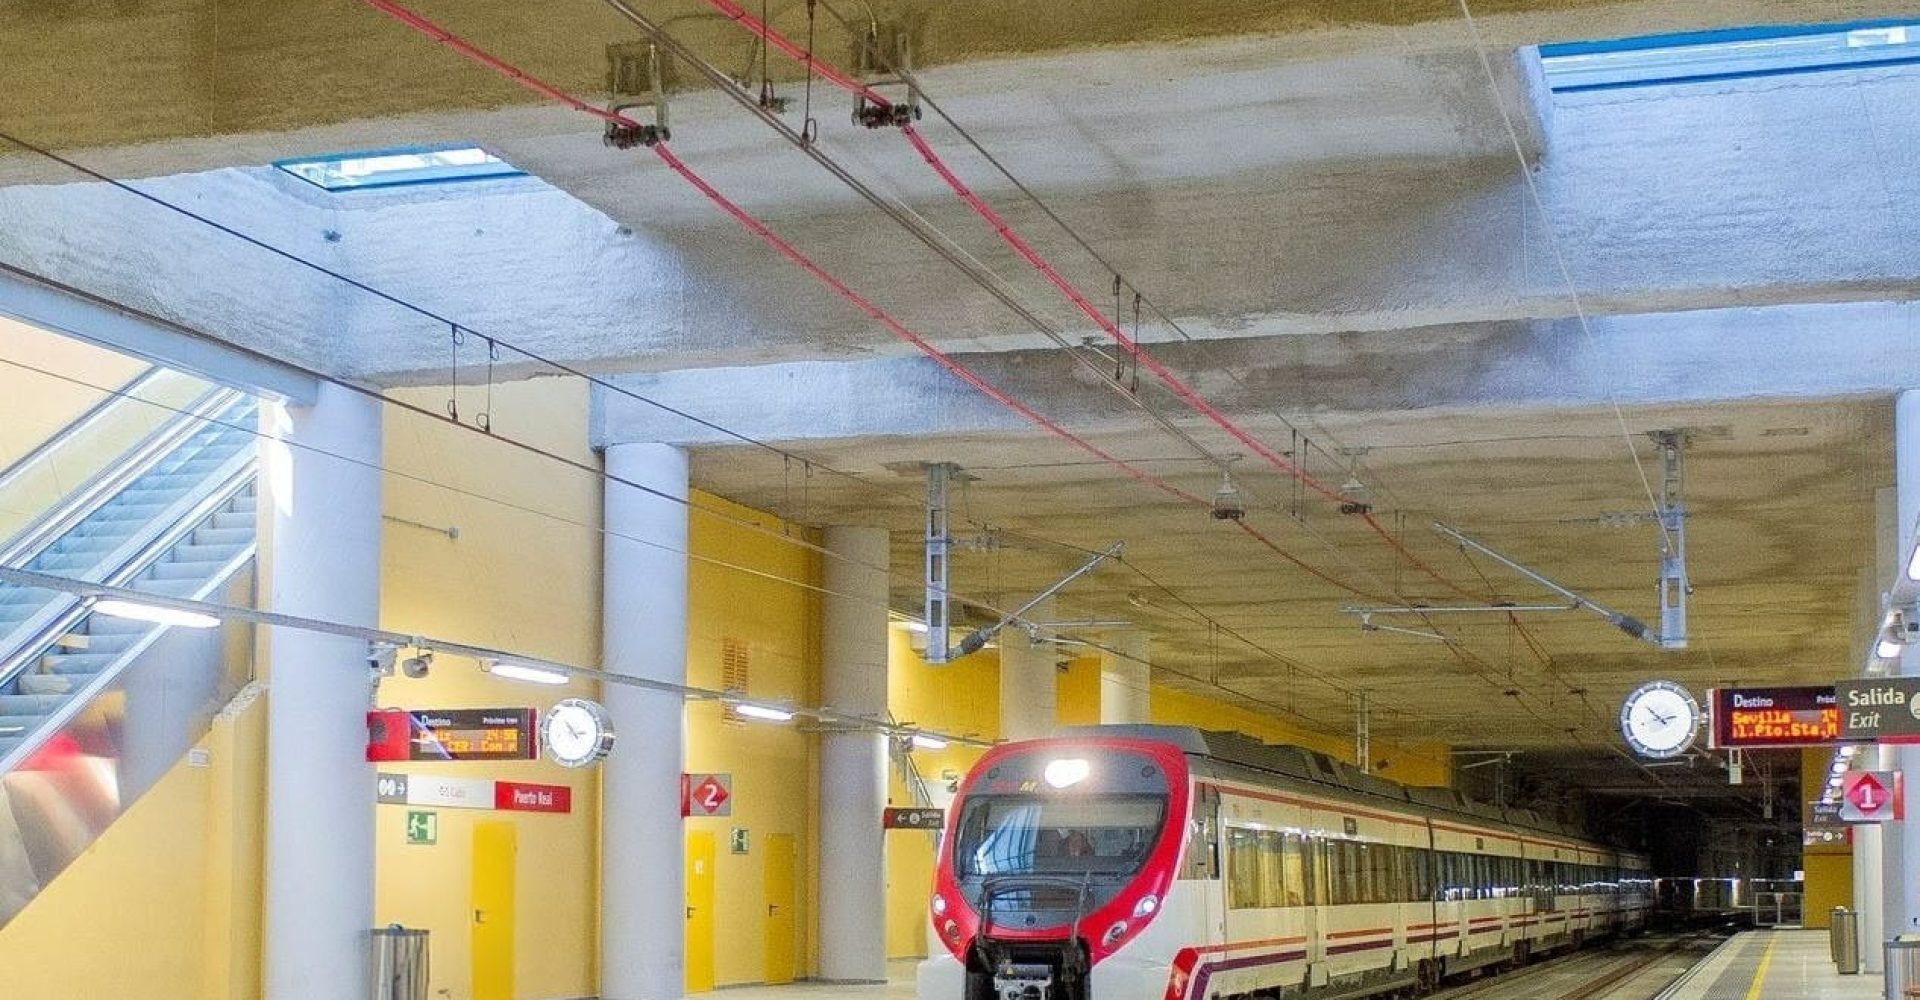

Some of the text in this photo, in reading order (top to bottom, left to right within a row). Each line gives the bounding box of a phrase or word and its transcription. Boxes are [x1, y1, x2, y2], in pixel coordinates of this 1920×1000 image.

[1734, 694, 1773, 708] Destino
[1849, 688, 1905, 707] Salida
[1732, 711, 1790, 724] Sevilla
[1849, 712, 1880, 729] Exit
[514, 789, 553, 806] Puerto Real
[703, 783, 718, 807] 2
[1859, 784, 1877, 808] 1
